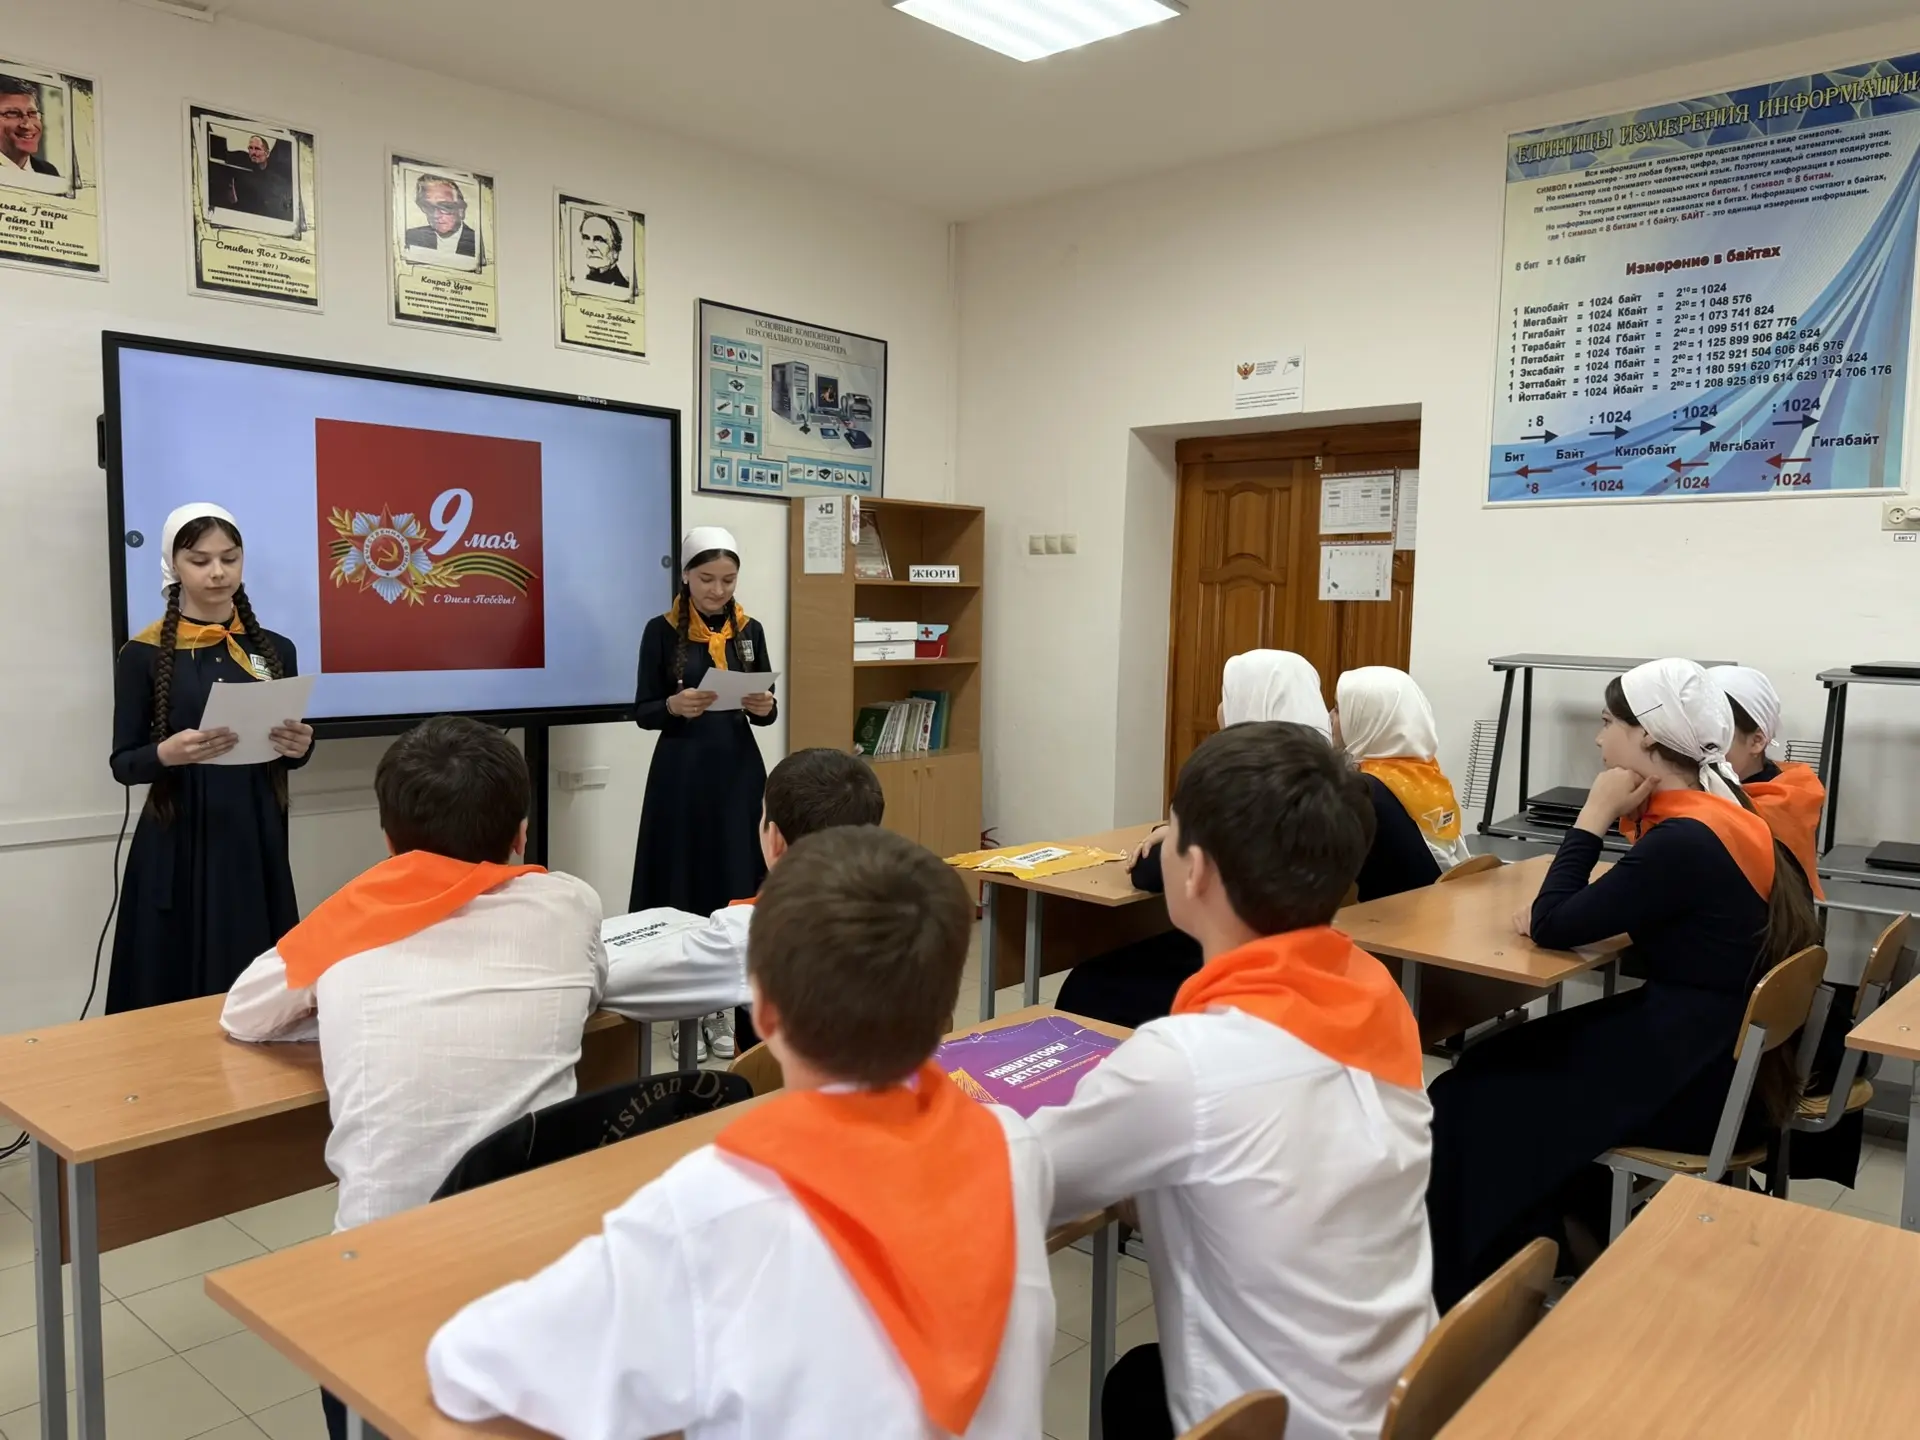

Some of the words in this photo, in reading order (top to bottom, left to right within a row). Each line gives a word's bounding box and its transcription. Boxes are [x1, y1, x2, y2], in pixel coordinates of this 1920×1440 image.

[1517, 128, 1613, 164] ЕДИНИЦЫ
[1619, 103, 1749, 146] ИЗМЕРЕНИЯ
[1795, 133, 1865, 151] математический
[1868, 130, 1891, 139] знак.
[1735, 161, 1768, 171] Поэтому
[1771, 153, 1803, 165] каждый
[1806, 149, 1838, 159] символ
[1840, 141, 1891, 154] кодируется.
[1712, 186, 1741, 196] битом.
[1751, 180, 1784, 189] символ
[1803, 172, 1834, 181] битам.
[31, 206, 68, 220] Генри
[1681, 211, 1705, 221] БАЙТ
[216, 241, 253, 254] Стивен
[257, 248, 276, 258] Пол
[280, 252, 310, 264] Джобс
[1515, 262, 1521, 271] 8
[1523, 260, 1539, 269] бит
[1564, 255, 1586, 264] байт
[1626, 255, 1709, 275] Измерение
[1714, 254, 1722, 264] в
[1727, 246, 1781, 262] байтах
[421, 276, 451, 287] Конрад
[1523, 315, 1568, 327] Мегабайт
[1589, 310, 1612, 320] 1024
[1618, 306, 1648, 317] Кбайт
[1709, 296, 1729, 307] 048
[1732, 294, 1752, 304] 576
[1524, 302, 1568, 314] Килобайт
[1590, 296, 1612, 307] 1024
[1618, 293, 1642, 303] байт
[1701, 283, 1727, 294] 1024
[755, 320, 792, 333] ОСНОВНЫЕ
[795, 328, 840, 343] КОМПОНЕНТЫ
[1522, 328, 1565, 340] Гигабайт
[1588, 323, 1611, 333] 1024
[1617, 319, 1648, 330] Мбайт
[1709, 309, 1728, 320] 073
[1732, 308, 1750, 317] 741
[1754, 305, 1774, 316] 824
[1522, 340, 1565, 353] Терабайт
[1588, 336, 1610, 346] 1024
[1616, 332, 1645, 343] Гбайт
[1708, 323, 1727, 333] 099
[1731, 321, 1749, 331] 511
[1753, 319, 1774, 329] 627
[1778, 317, 1797, 327] 776
[746, 328, 802, 345] ПЕРСОНАЛЬНОГО
[805, 341, 847, 355] КОМПЬЮТЕРА
[1521, 353, 1564, 365] Петабайт
[1587, 348, 1609, 358] 1024
[1616, 345, 1645, 355] Тбайт
[1707, 337, 1726, 347] 125
[1729, 335, 1749, 345] 899
[1753, 333, 1772, 343] 906
[1776, 331, 1796, 341] 842
[1800, 328, 1820, 338] 624
[1519, 378, 1566, 390] Зеттабайт
[1585, 374, 1608, 384] 1024
[1614, 371, 1643, 381] Эбайт
[1706, 364, 1724, 374] 180
[1728, 362, 1746, 372] 591
[1751, 361, 1770, 370] 620
[1774, 359, 1794, 368] 717
[1798, 357, 1817, 367] 411
[1822, 354, 1842, 365] 303
[1847, 353, 1867, 362] 424
[1520, 366, 1564, 377] Эксабайт
[1586, 361, 1608, 371] 1024
[1615, 359, 1645, 369] Пбайт
[1706, 350, 1725, 360] 152
[1729, 349, 1747, 359] 921
[1751, 347, 1771, 357] 504
[1775, 344, 1795, 354] 606
[1799, 343, 1819, 353] 846
[1823, 340, 1843, 350] 976
[1518, 391, 1566, 402] Йоттабайт
[1584, 387, 1607, 397] 1024
[1613, 384, 1643, 394] Йбайт
[1704, 378, 1723, 388] 208
[1727, 376, 1746, 386] 925
[1750, 374, 1769, 384] 819
[1773, 373, 1793, 383] 614
[1797, 371, 1817, 380] 629
[1822, 369, 1842, 378] 174
[1846, 367, 1866, 377] 706
[1871, 365, 1891, 375] 176
[1536, 416, 1544, 426] 8
[1599, 411, 1631, 423] 1024
[1683, 404, 1717, 418] 1024
[1783, 398, 1820, 412] 1024
[1505, 452, 1524, 462] Бит
[1556, 449, 1585, 459] Байт
[1615, 445, 1676, 456] Килобайт
[1709, 439, 1775, 452] Мегабайт
[1812, 434, 1879, 447] Гигабайт
[1592, 480, 1623, 491] 1024
[1675, 477, 1710, 489] 1024
[1774, 473, 1811, 486] 1024
[428, 488, 473, 555] 9
[464, 532, 520, 549] мая
[365, 530, 406, 570] ОТЕЧЕСТВЕННАЯ
[912, 570, 955, 578] ЖЮРИ
[434, 595, 440, 603] С
[444, 595, 470, 604] Днем
[473, 595, 516, 605] Победы!
[985, 1043, 1068, 1079] НАВИГАТОРЫ
[1004, 1059, 1062, 1086] ДЕТСТВА
